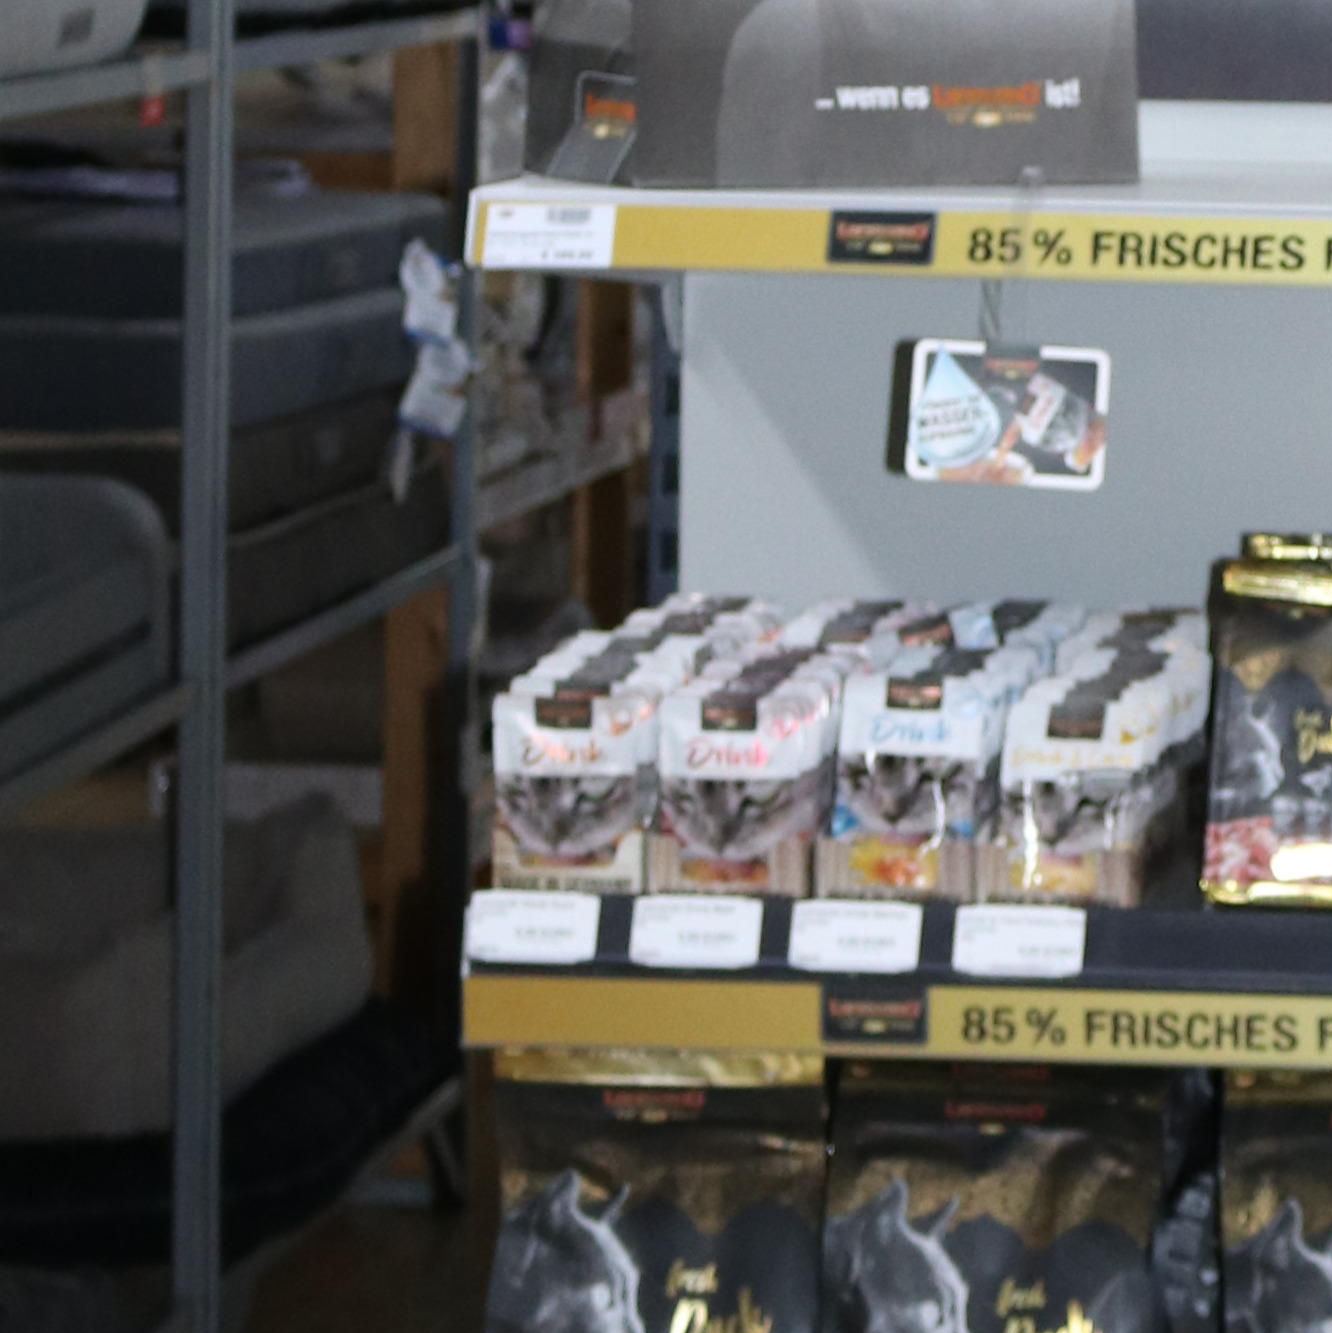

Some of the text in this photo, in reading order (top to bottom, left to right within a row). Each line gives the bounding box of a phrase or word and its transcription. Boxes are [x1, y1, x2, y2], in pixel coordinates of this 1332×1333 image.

[968, 228, 1024, 265] 85
[1092, 231, 1307, 273] FRISCHES
[687, 736, 770, 768] Drink
[962, 1006, 1019, 1046] 85
[1085, 1010, 1300, 1054] FRISCHES
